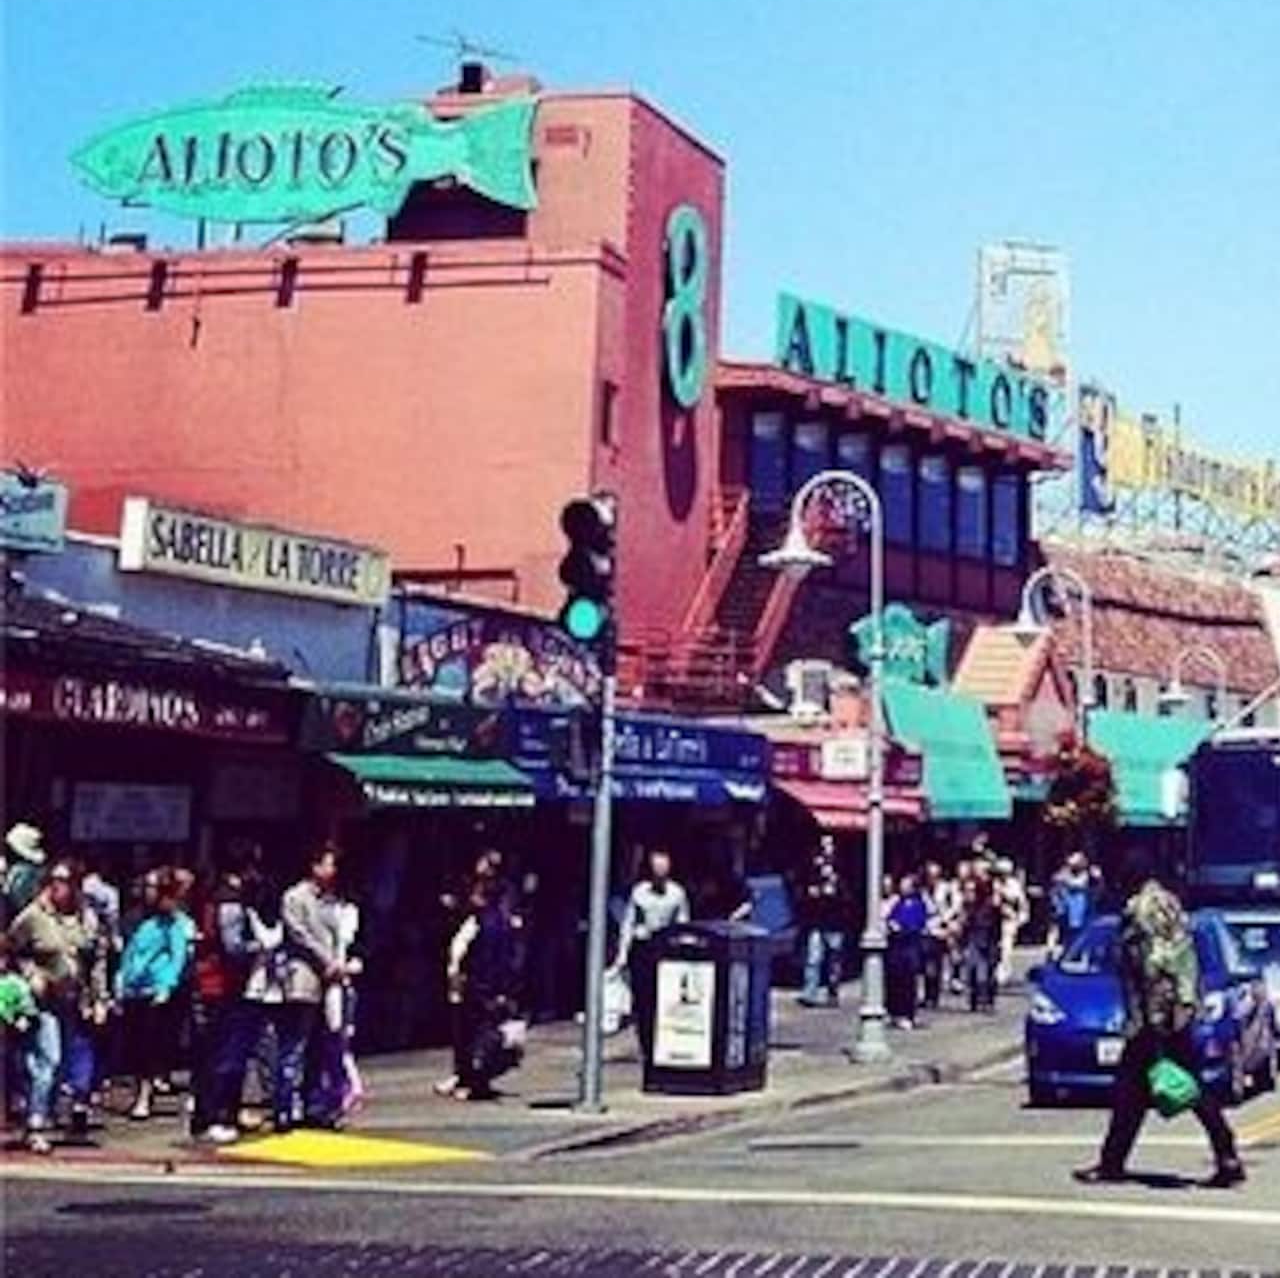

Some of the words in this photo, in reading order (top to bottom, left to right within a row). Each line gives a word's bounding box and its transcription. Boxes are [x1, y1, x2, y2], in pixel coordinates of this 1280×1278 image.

[137, 124, 408, 190] ALIOTO'S
[782, 302, 1048, 442] ALIOTO'S
[150, 512, 243, 574] SABELLA
[266, 538, 290, 580] LA
[298, 543, 361, 592] TORRE
